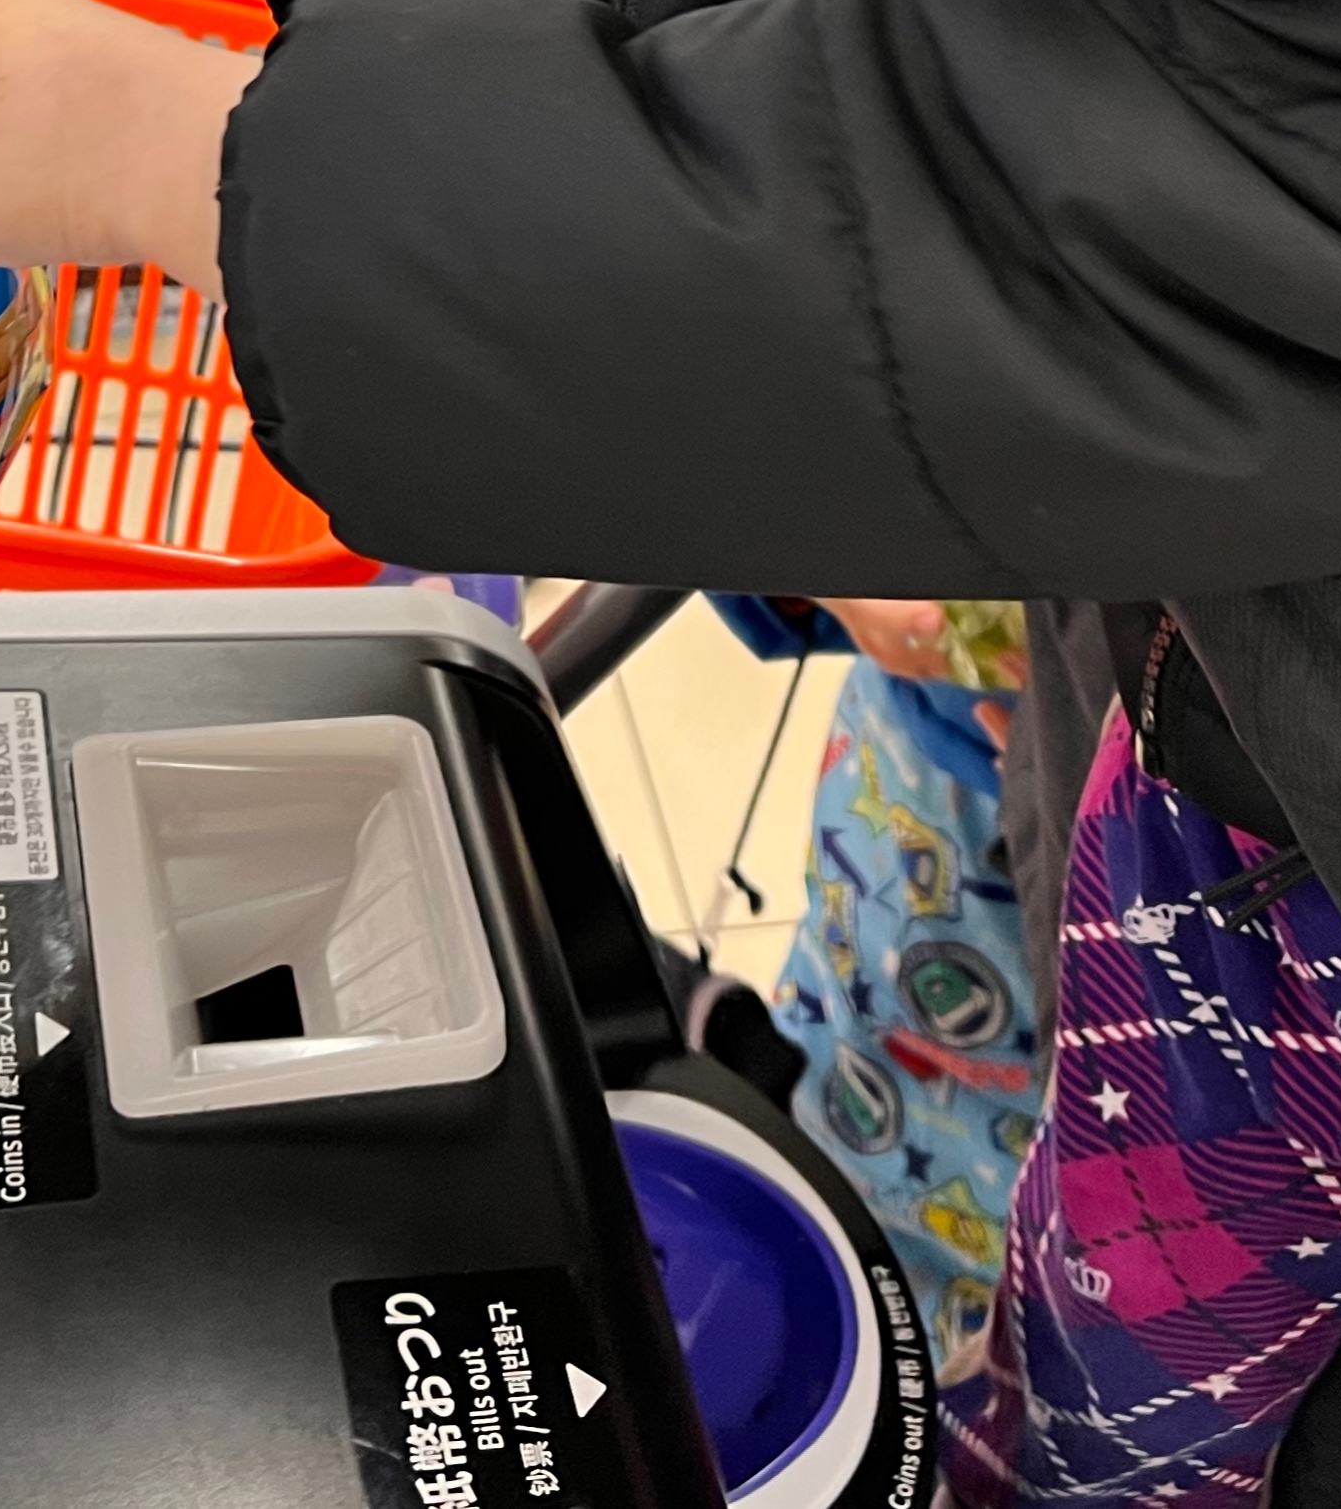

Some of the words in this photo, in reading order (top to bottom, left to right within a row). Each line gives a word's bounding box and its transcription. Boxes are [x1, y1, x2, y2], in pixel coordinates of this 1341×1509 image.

[459, 1347, 490, 1390] out
[487, 1301, 539, 1418] 지폐반환구
[384, 1292, 480, 1509] 紙幣おつり
[468, 1395, 505, 1450] Bills
[902, 1415, 924, 1450] out
[519, 1441, 560, 1497] 钞票
[887, 1454, 921, 1509] Coins
